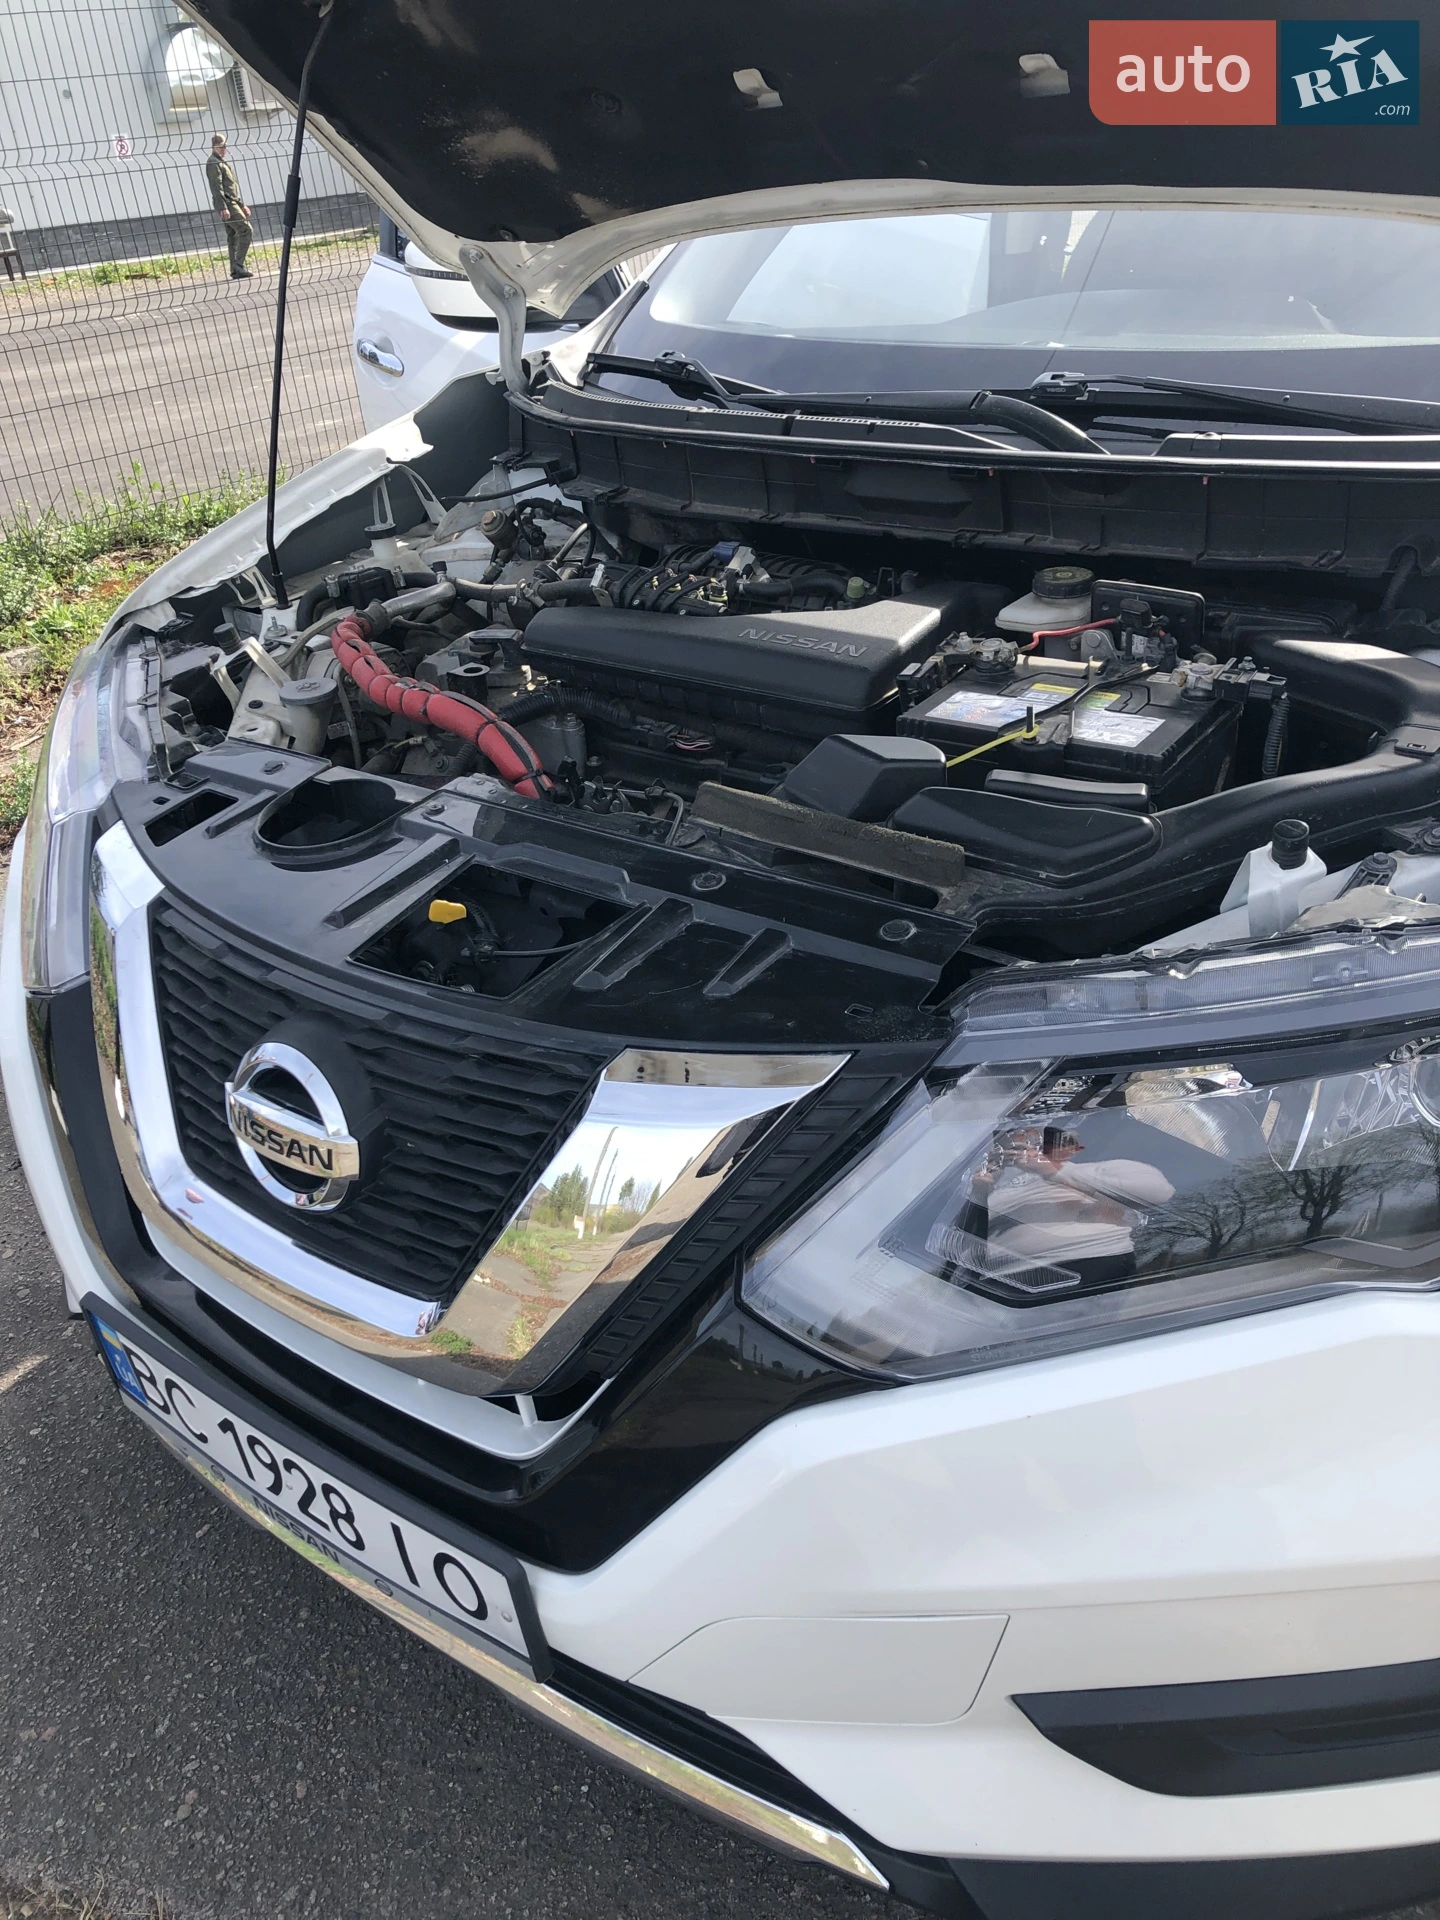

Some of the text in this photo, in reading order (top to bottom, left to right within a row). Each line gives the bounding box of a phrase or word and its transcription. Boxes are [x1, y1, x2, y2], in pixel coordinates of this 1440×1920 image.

[738, 628, 868, 657] NISSAN
[230, 1102, 333, 1171] NISSAN
[122, 1342, 489, 1622] BC 1928 IO
[252, 1495, 341, 1564] NISSAN
